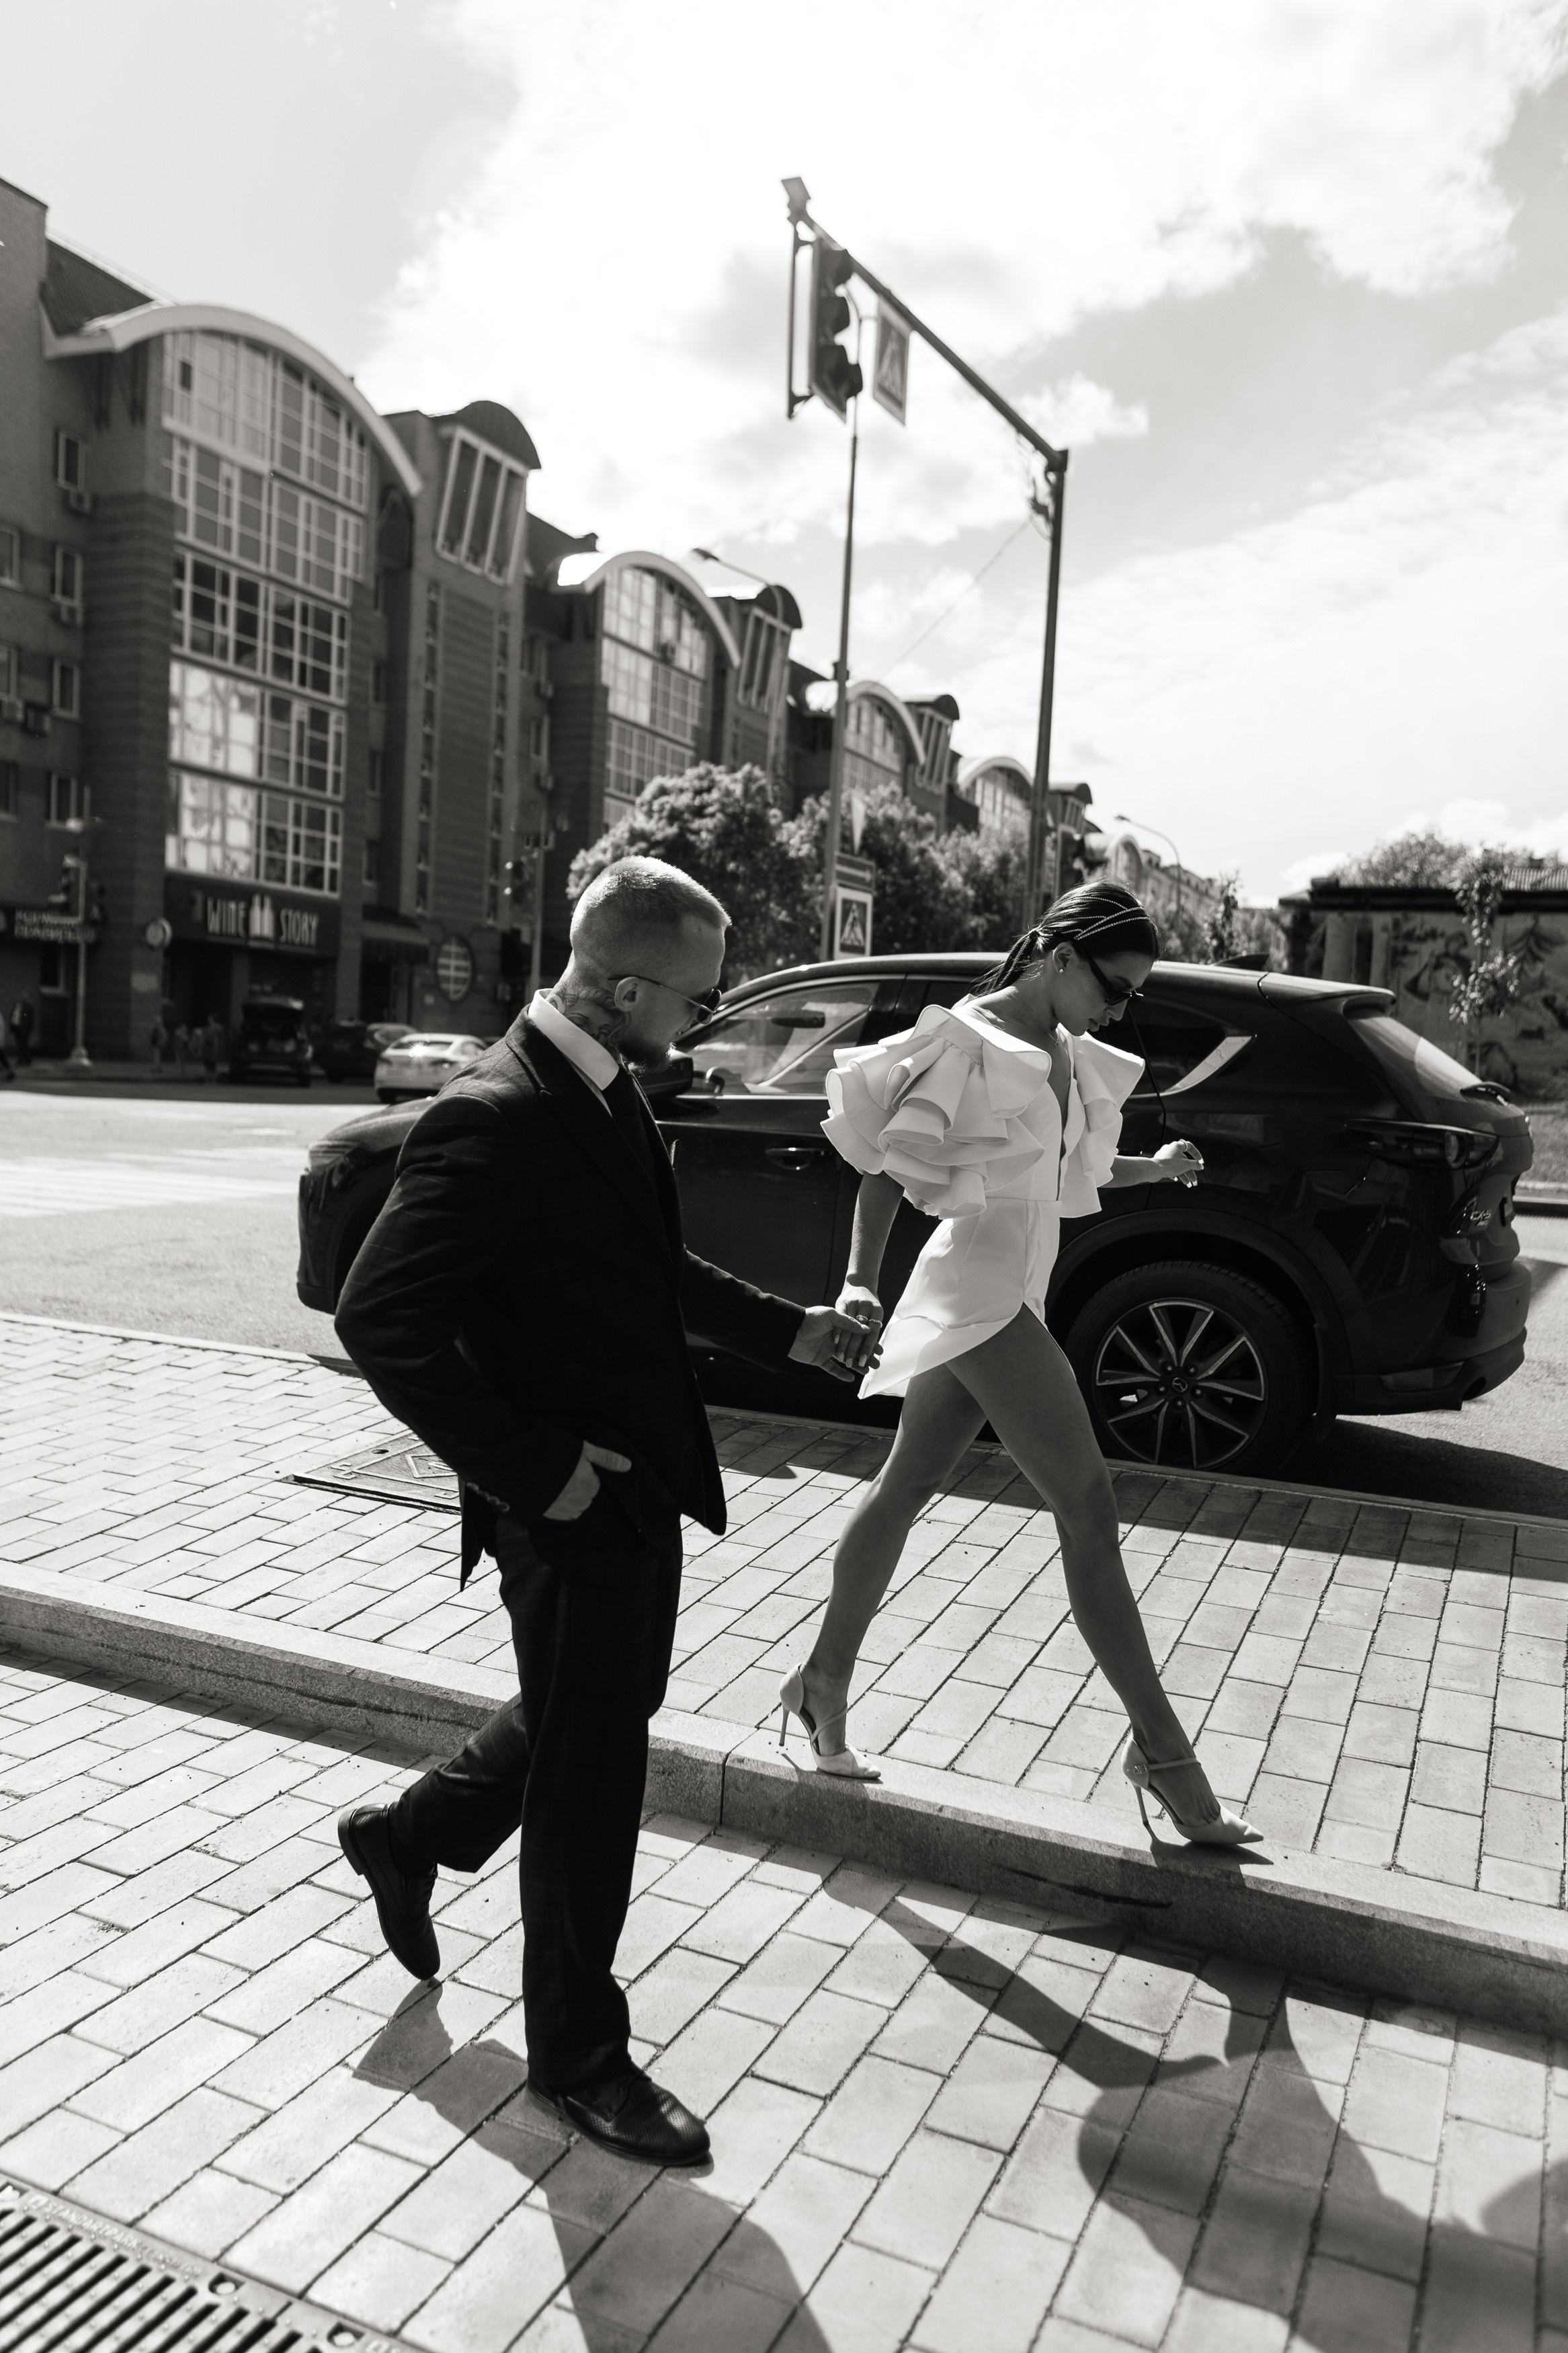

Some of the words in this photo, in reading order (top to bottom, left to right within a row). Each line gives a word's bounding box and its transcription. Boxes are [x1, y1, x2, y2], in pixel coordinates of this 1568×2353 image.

[207, 897, 247, 938] WINE
[279, 908, 319, 947] STORY
[1470, 1210, 1491, 1220] CX-5
